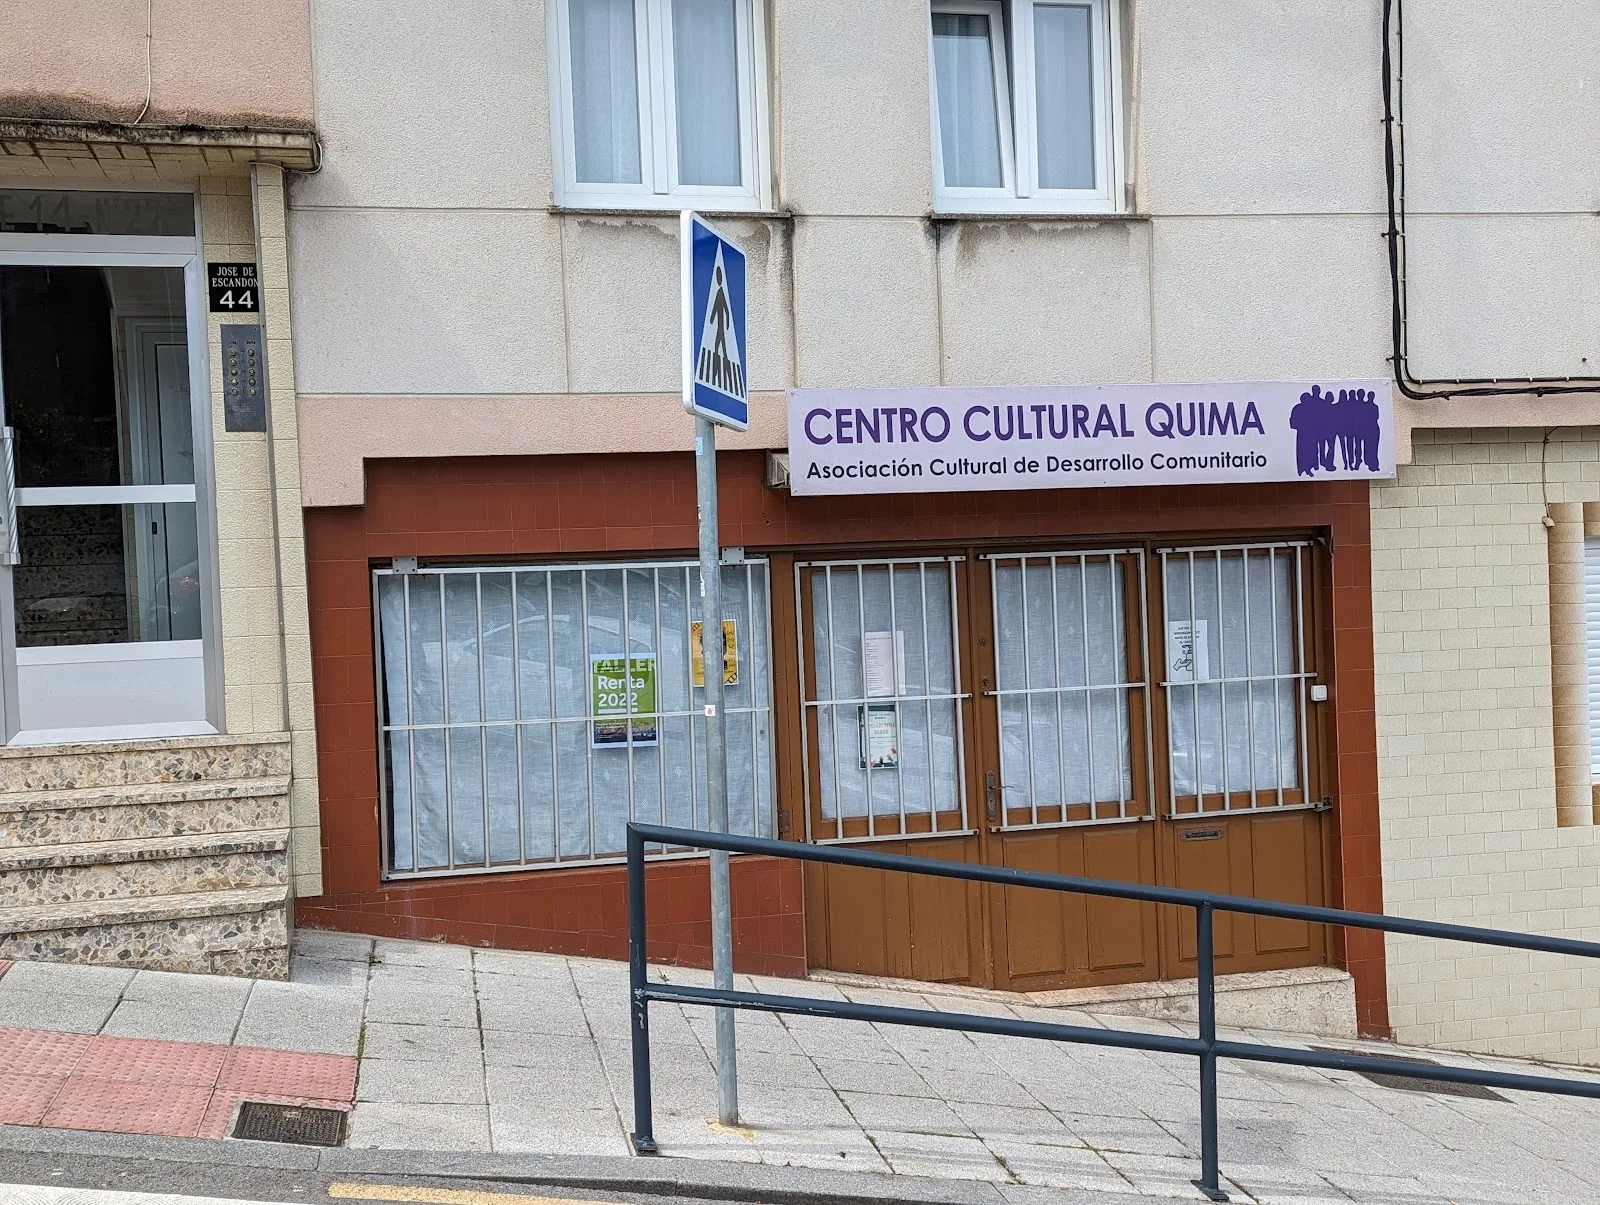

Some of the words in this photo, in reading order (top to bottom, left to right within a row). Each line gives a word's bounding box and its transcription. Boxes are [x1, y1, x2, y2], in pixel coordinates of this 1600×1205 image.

[217, 267, 238, 276] JOSE
[243, 267, 254, 276] DE
[212, 278, 259, 287] ESCANDON
[220, 290, 254, 308] 44
[804, 407, 951, 445] CENTRO
[963, 403, 1134, 442] CULTURAL
[1145, 402, 1265, 439] QUIMA
[807, 458, 922, 479] Asociación
[930, 457, 1007, 476] Cultural
[1013, 457, 1040, 474] de
[1047, 454, 1144, 473] Desarrollo
[1150, 451, 1267, 471] Comunitario
[593, 659, 656, 673] TALER
[598, 676, 645, 690] Renta
[598, 692, 638, 707] 2022
